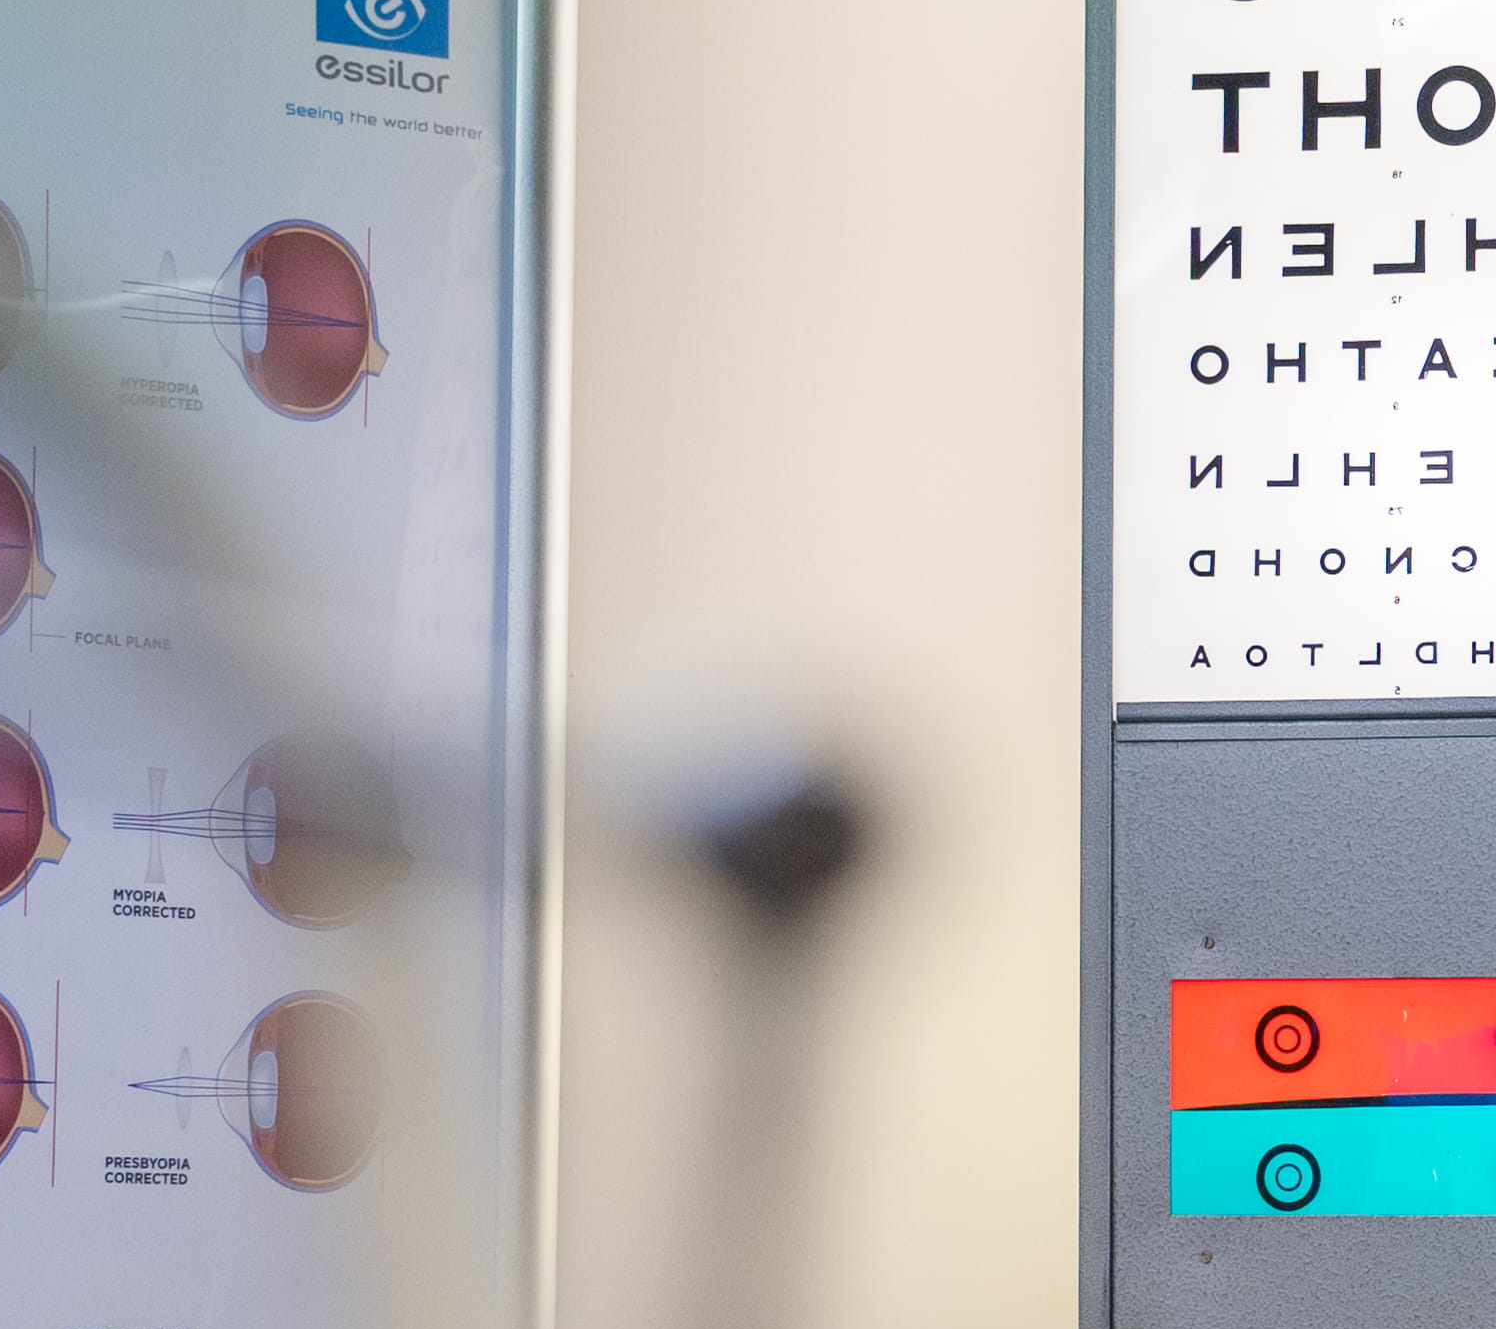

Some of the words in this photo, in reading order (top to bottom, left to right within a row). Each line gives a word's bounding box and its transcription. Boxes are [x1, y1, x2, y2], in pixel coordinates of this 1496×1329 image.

[285, 103, 344, 126] Seeing
[350, 110, 378, 128] the
[384, 115, 428, 134] world
[434, 122, 484, 140] better
[75, 631, 122, 648] FOCAL
[126, 635, 172, 651] PLANE
[113, 888, 167, 904] MYOPIA
[112, 904, 196, 920] CORRECTED
[105, 1156, 191, 1171] PRESBYOPIA
[104, 1171, 189, 1186] CORRECTED
